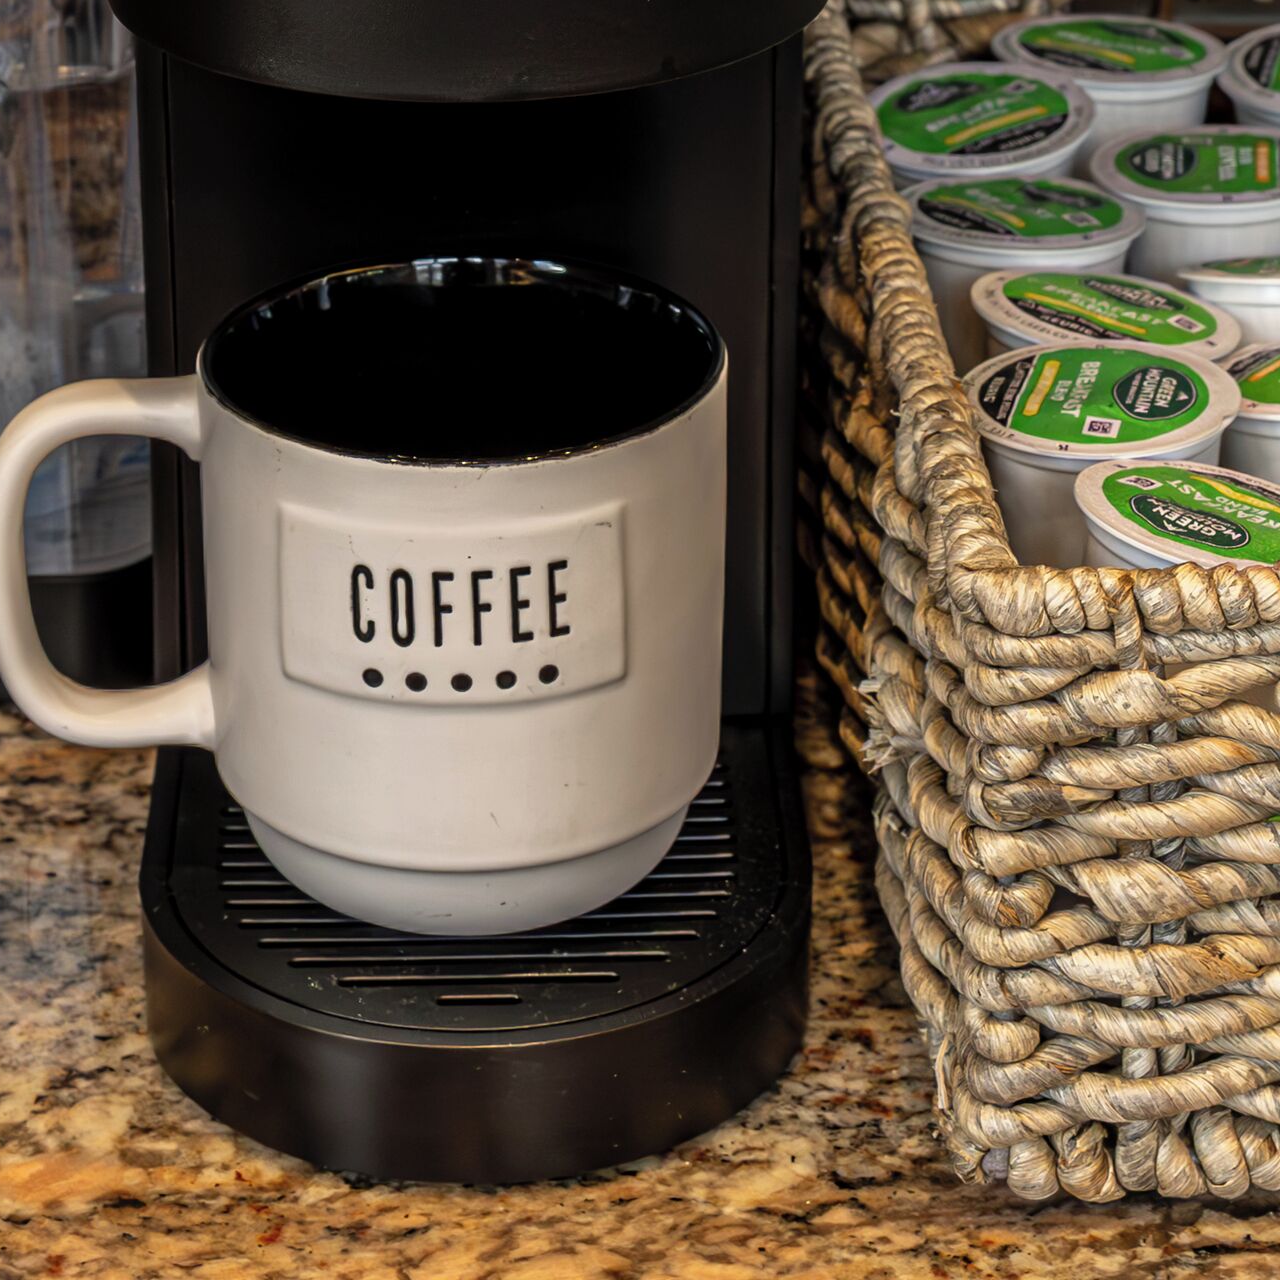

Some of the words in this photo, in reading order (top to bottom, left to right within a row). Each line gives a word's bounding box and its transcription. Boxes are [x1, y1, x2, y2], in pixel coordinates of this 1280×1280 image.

[1061, 361, 1101, 418] BREAKFAST
[1134, 368, 1163, 413] MOUNTAIN
[1154, 377, 1177, 408] GREEN
[1152, 506, 1217, 537] GREEN
[1215, 496, 1270, 516] BLEND
[350, 559, 571, 648] COFFEE
